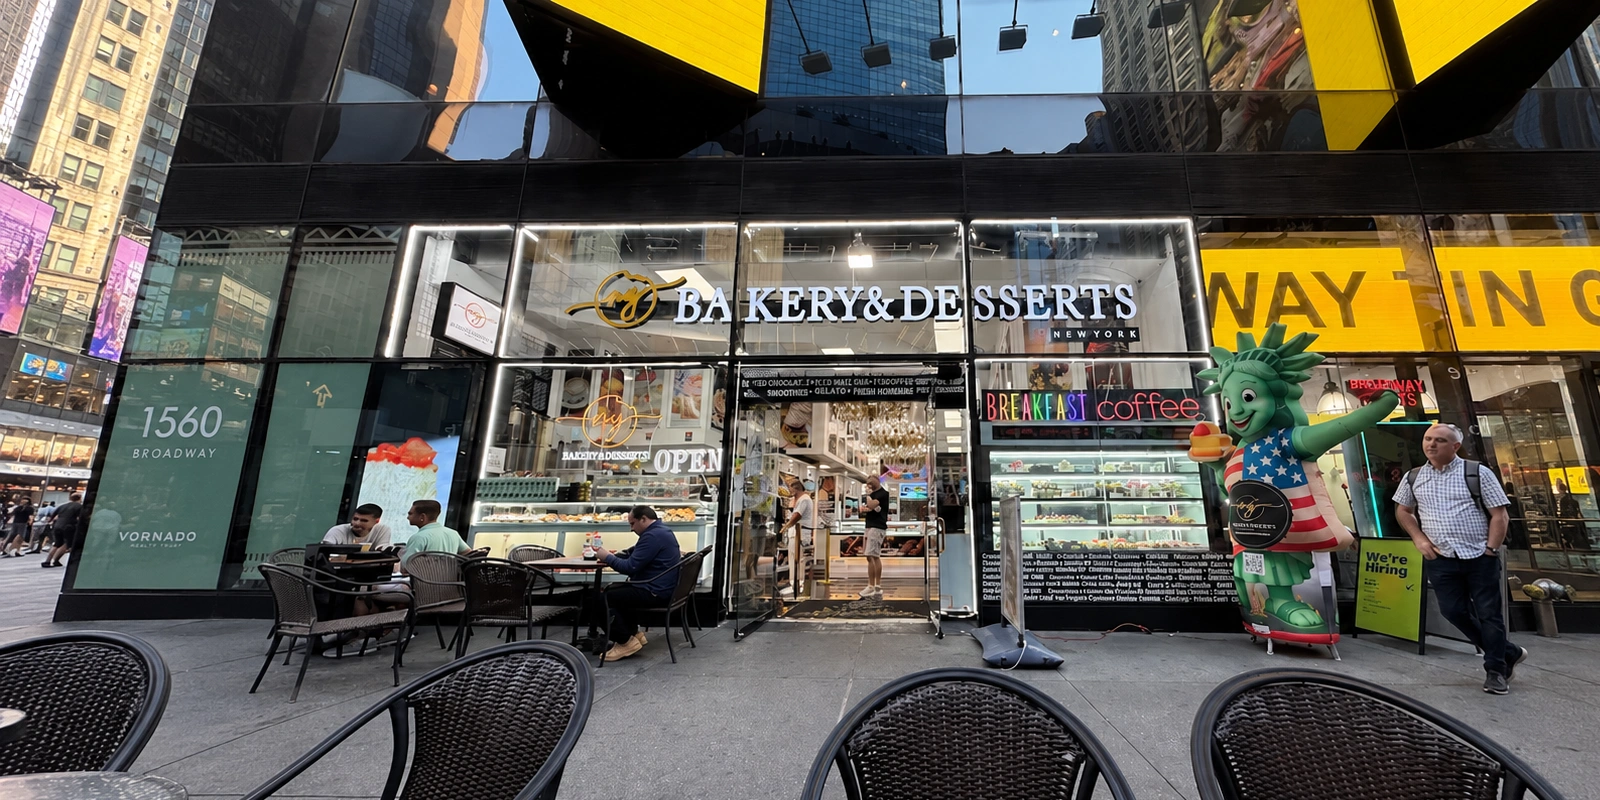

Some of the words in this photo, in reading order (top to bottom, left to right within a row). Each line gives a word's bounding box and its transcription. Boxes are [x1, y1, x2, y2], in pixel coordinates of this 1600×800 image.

[1392, 270, 1546, 327] IN
[986, 392, 1087, 421] BREAKFAST
[1096, 391, 1200, 421] coffee
[142, 405, 223, 438] 1560
[132, 448, 217, 459] BROADWAY
[653, 448, 723, 474] OPEN
[119, 531, 197, 542] VORNADO
[1365, 562, 1408, 578] Hiring
[1366, 551, 1408, 565] We're
